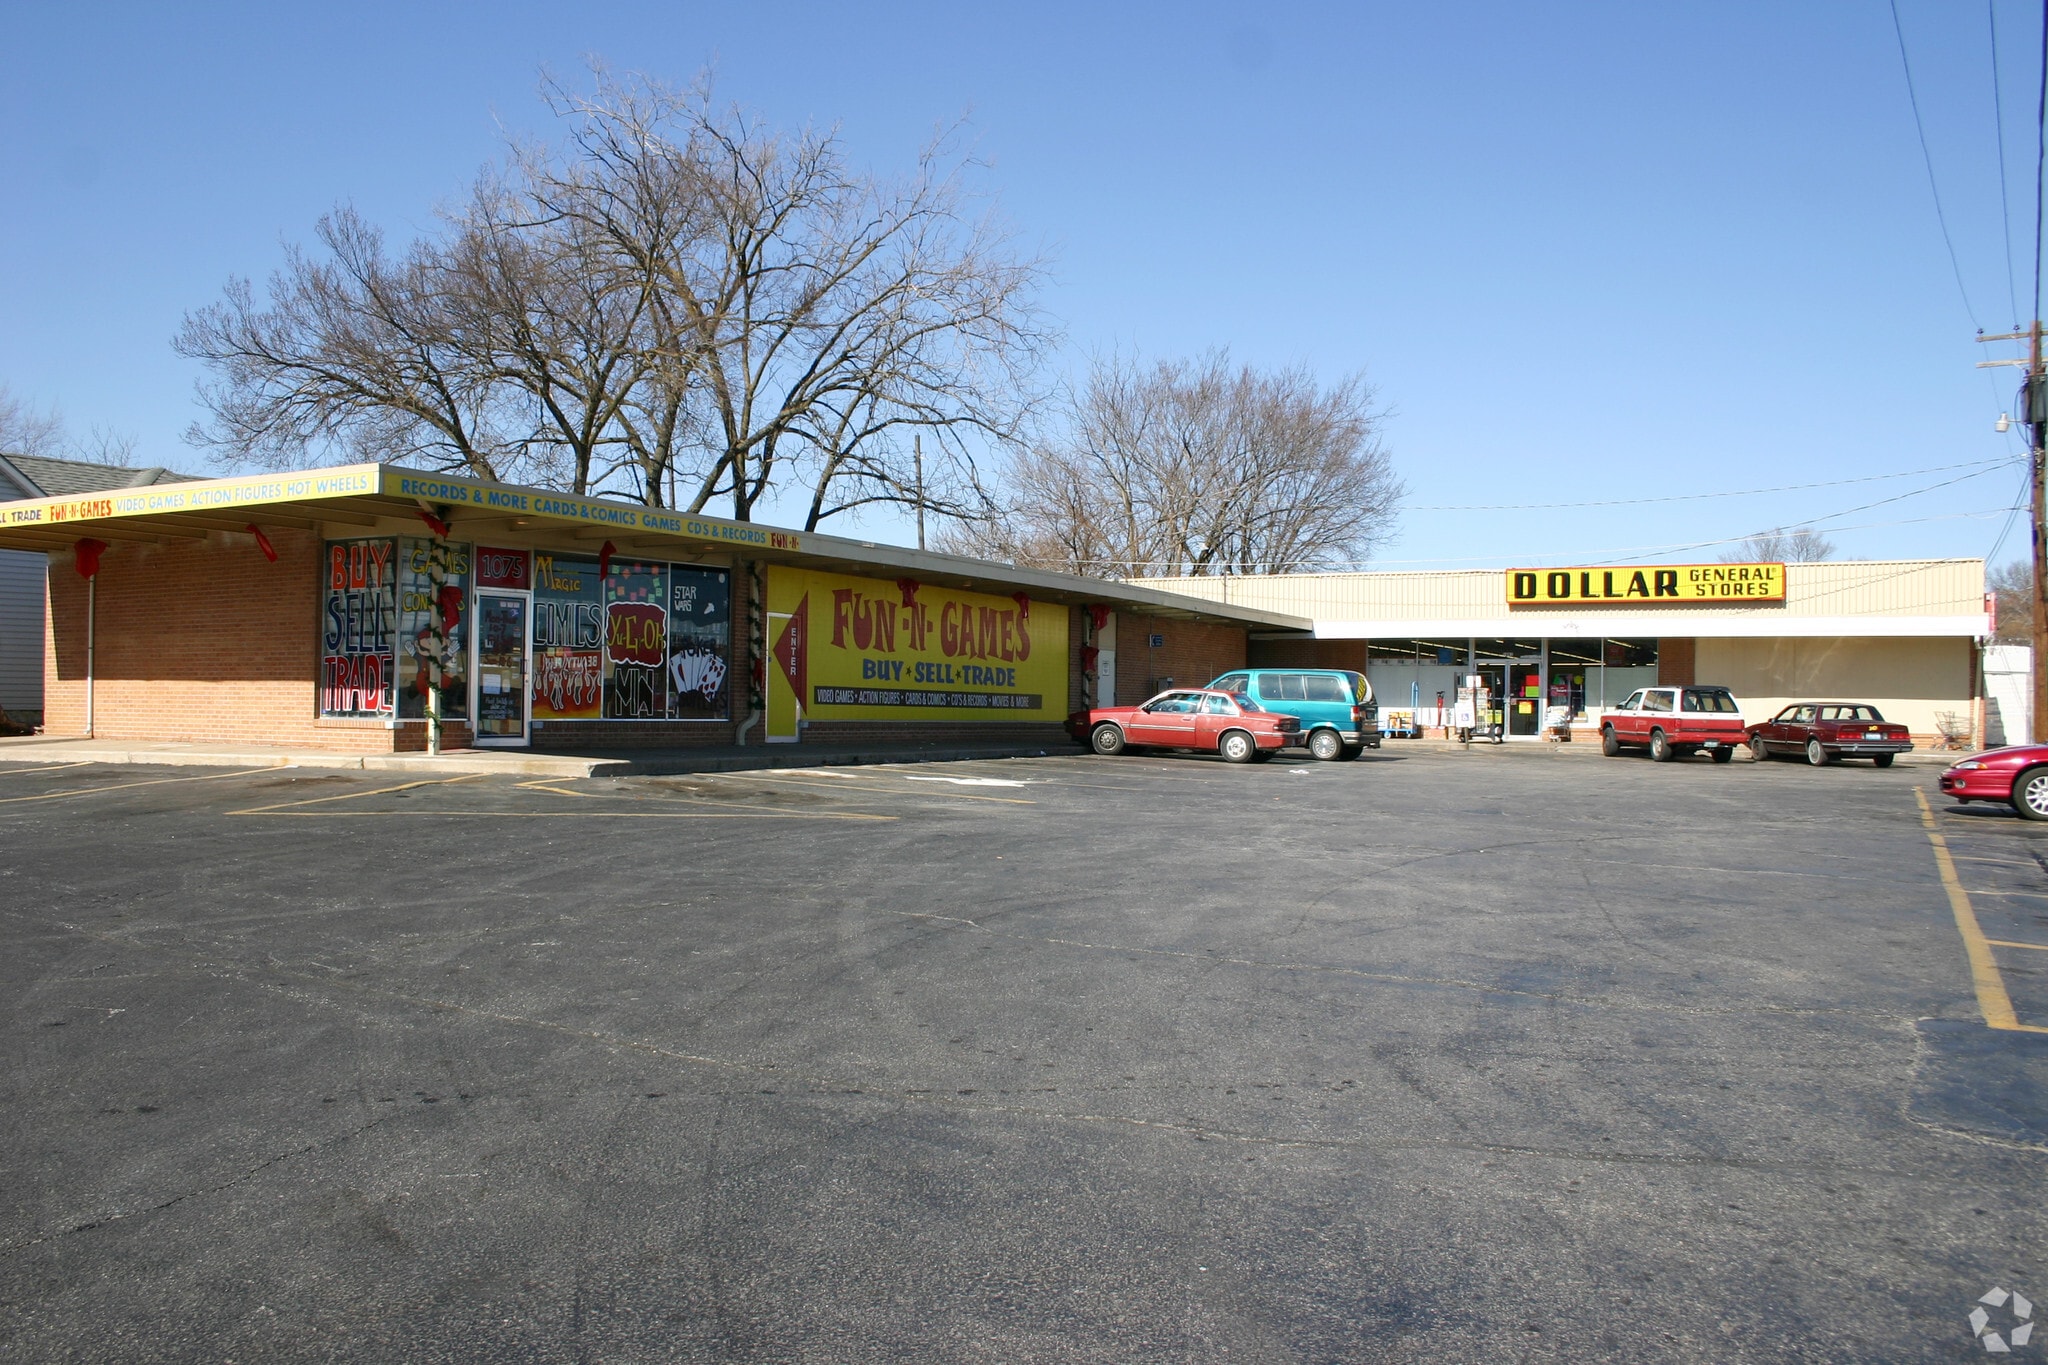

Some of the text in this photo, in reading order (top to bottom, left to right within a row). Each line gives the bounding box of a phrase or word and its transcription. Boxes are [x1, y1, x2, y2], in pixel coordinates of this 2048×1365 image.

[11, 509, 42, 522] TRADE
[49, 504, 67, 521] FUN
[80, 499, 112, 518] GAMES
[116, 498, 146, 512] VIDEO
[149, 494, 185, 509] GAMES
[191, 489, 232, 505] ACTION
[235, 484, 282, 501] FIGURES
[287, 481, 311, 496] HOT
[316, 475, 368, 493] WHEELS
[401, 479, 468, 501] RECORDS
[472, 489, 484, 503] &
[488, 491, 528, 510] MORE
[534, 498, 578, 517] CARDS
[580, 504, 590, 518] &
[591, 508, 636, 525] COMICS
[642, 514, 681, 531] GAMES
[712, 525, 720, 537] &
[722, 527, 766, 544] RECORDS
[770, 532, 788, 548] FUN
[331, 542, 392, 590] BUY
[482, 555, 523, 578] 1075
[1690, 567, 1774, 582] GENERAL
[674, 586, 697, 600] STAR
[1514, 570, 1680, 599] DOLLAR
[1696, 582, 1769, 596] STORES
[674, 600, 692, 612] WARS
[325, 591, 390, 653] SELL
[533, 602, 602, 648] COMICS
[830, 588, 898, 652] FUN
[940, 600, 1031, 663] GAMES
[324, 654, 393, 712] TRADE
[862, 658, 1016, 687] BUY SELL TRADE
[817, 688, 833, 703] VIDEO
[835, 689, 855, 703] GAMES
[858, 690, 878, 704] ACTION
[880, 691, 900, 705] FIGURES
[905, 692, 922, 705] CARDS
[927, 693, 946, 706] COMICS
[967, 694, 988, 707] RECORDS
[992, 695, 1009, 707] MOVIES
[1016, 696, 1029, 708] MORE
